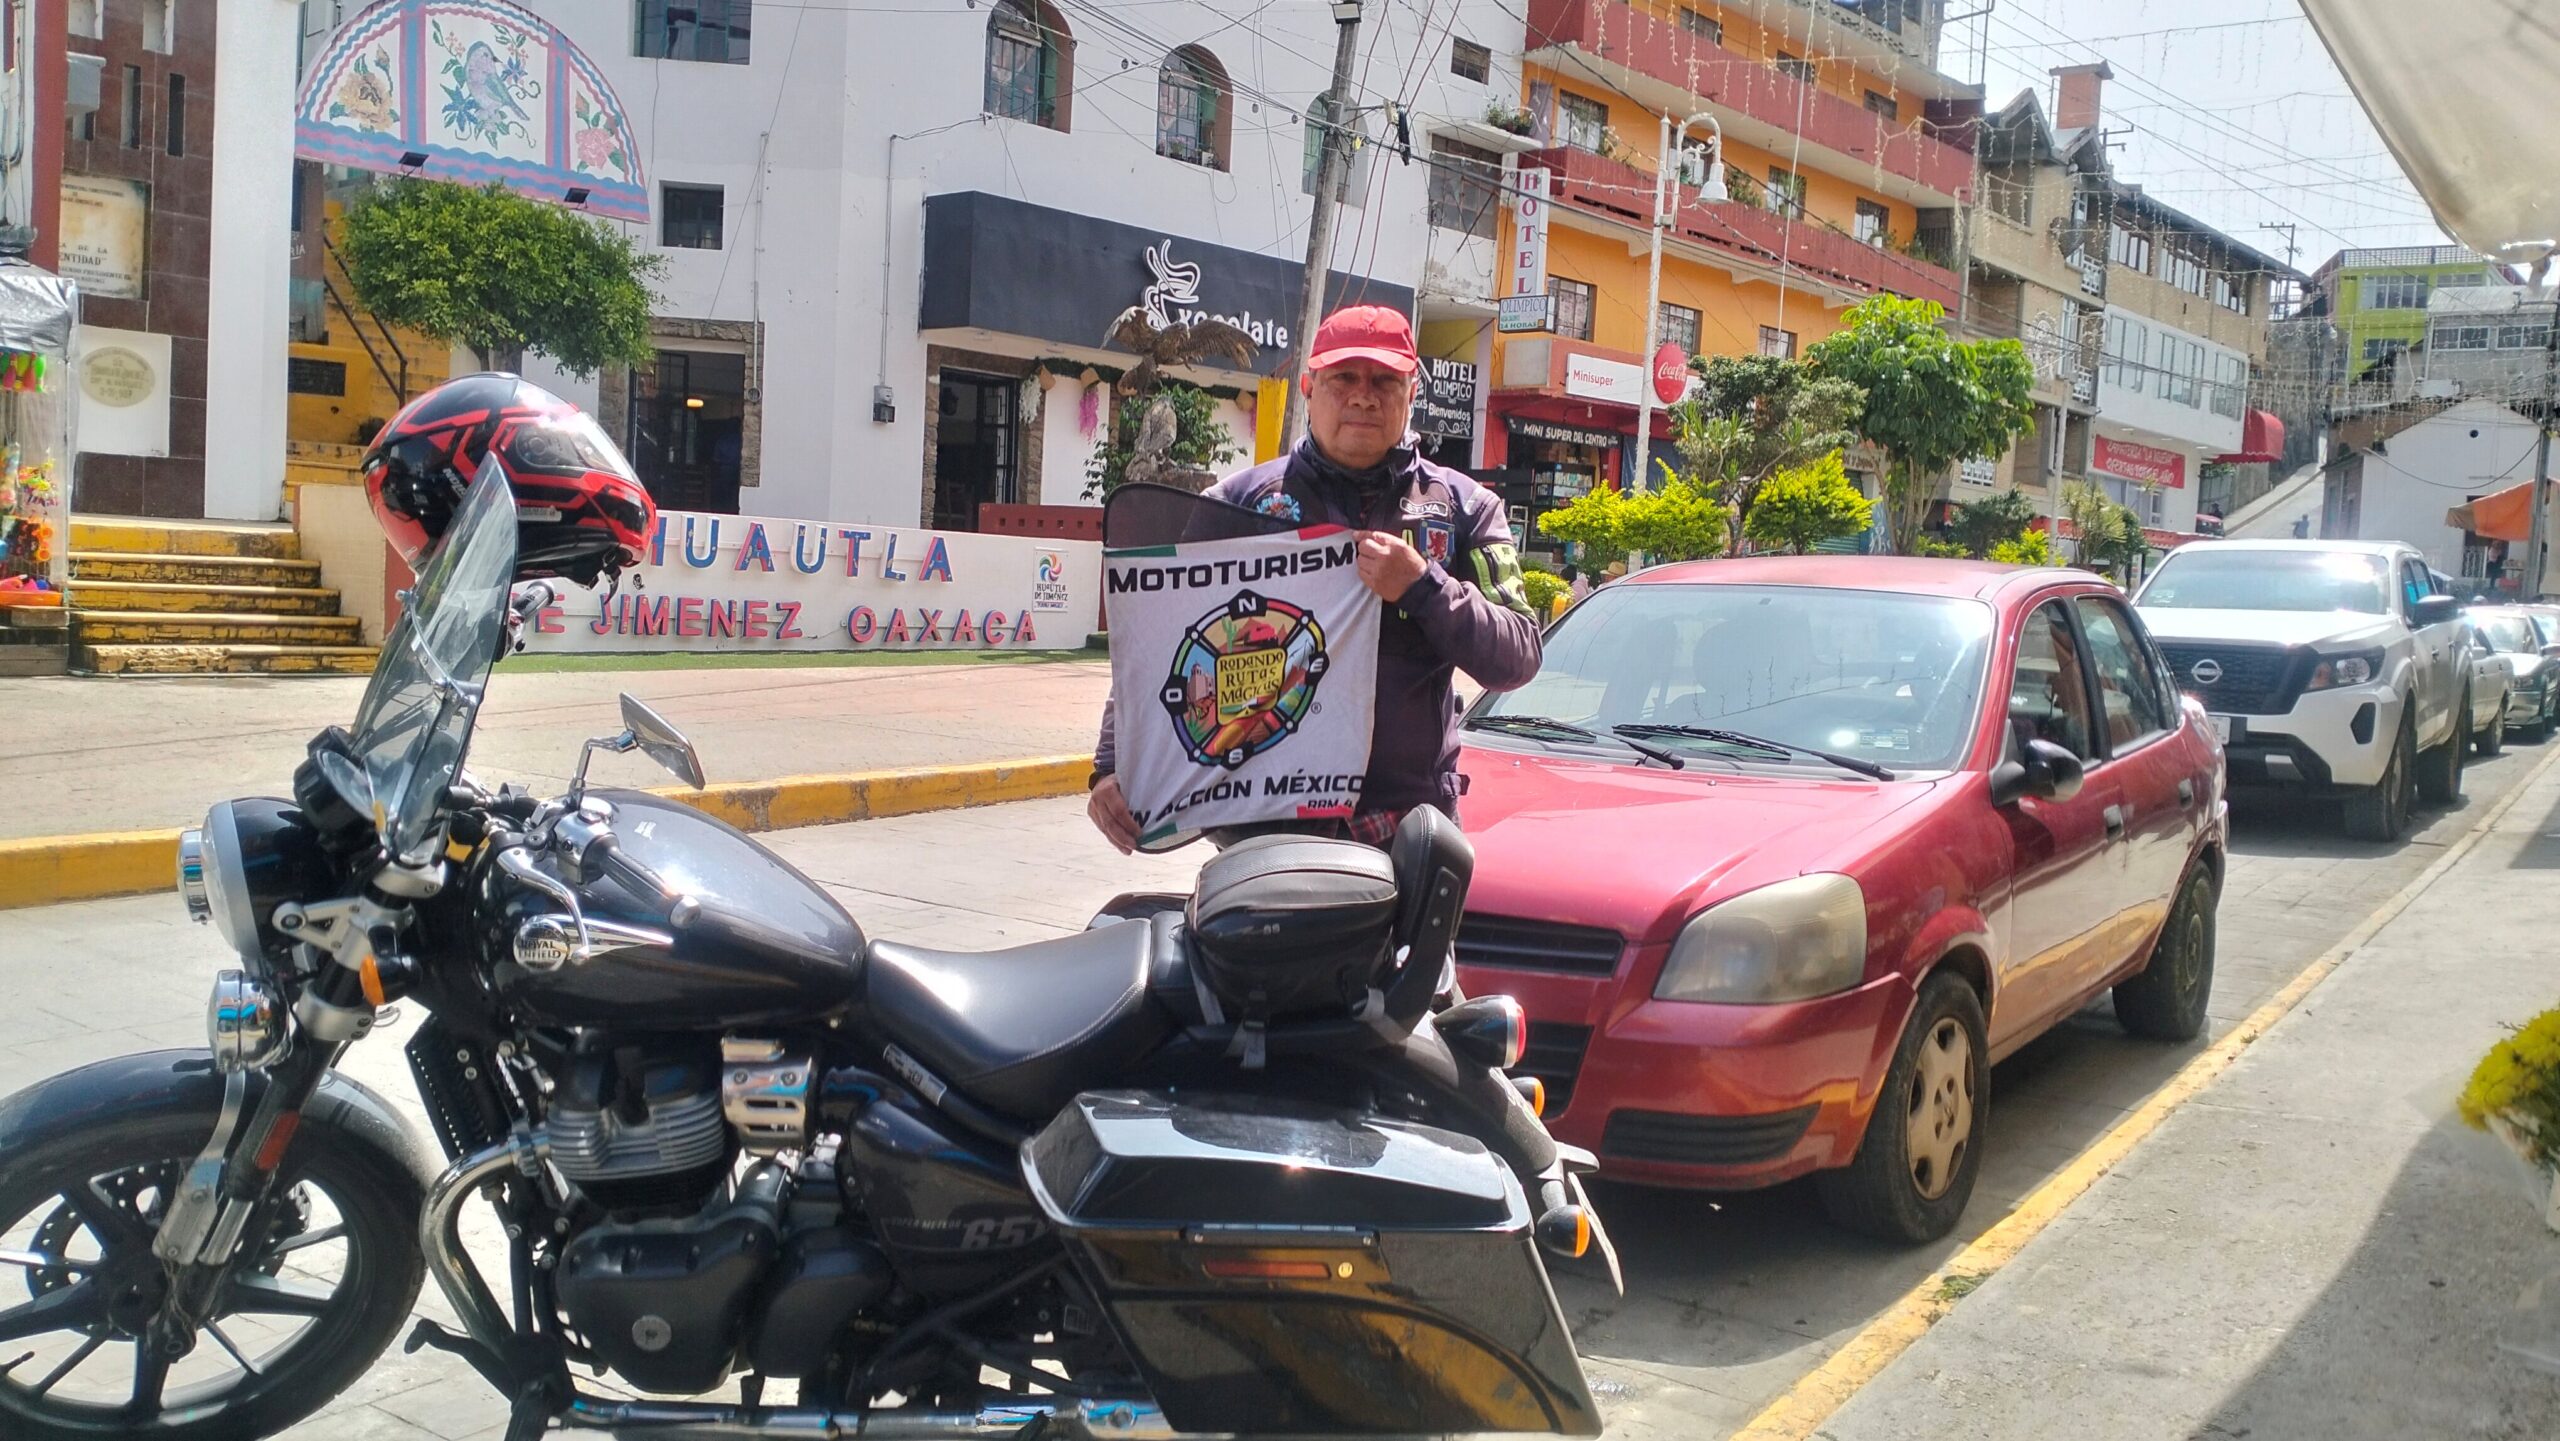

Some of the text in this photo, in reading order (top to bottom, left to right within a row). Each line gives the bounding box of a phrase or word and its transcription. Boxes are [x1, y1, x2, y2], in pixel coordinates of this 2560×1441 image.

[1517, 174, 1538, 294] HOTEL
[1502, 298, 1546, 313] OLIMPICO
[1432, 358, 1476, 383] HOTEL
[1573, 369, 1613, 388] Minisuper
[1433, 379, 1472, 398] OLIMPICO
[1428, 402, 1471, 421] Bienvenidos
[1523, 423, 1544, 437] MINI
[1545, 426, 1572, 442] SUPER
[1573, 432, 1584, 443] DEL
[1585, 433, 1607, 447] CENTRO
[1108, 541, 1359, 593] MOTOTURISM
[1238, 597, 1257, 613] N
[590, 592, 803, 640] JIMENEZ
[848, 605, 1037, 645] OAXACA
[1129, 769, 1364, 829] N ACCIÓN MÉXICO
